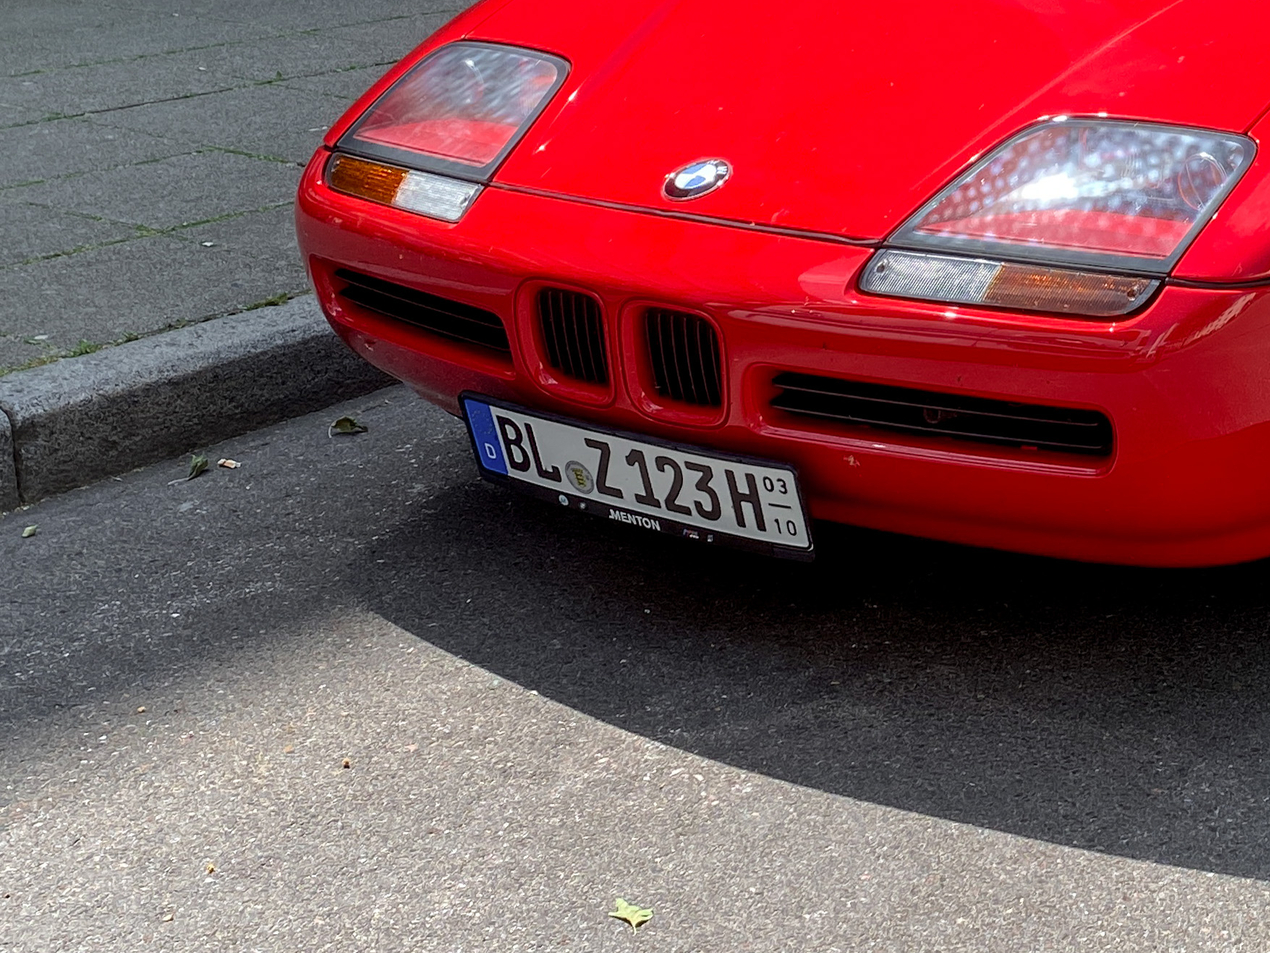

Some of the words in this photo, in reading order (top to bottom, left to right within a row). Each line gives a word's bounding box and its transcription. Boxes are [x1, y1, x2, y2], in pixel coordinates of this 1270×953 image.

[484, 442, 497, 459] D
[496, 415, 562, 482] BL
[762, 476, 789, 495] 03
[609, 509, 661, 531] MENTON
[774, 518, 797, 536] 10
